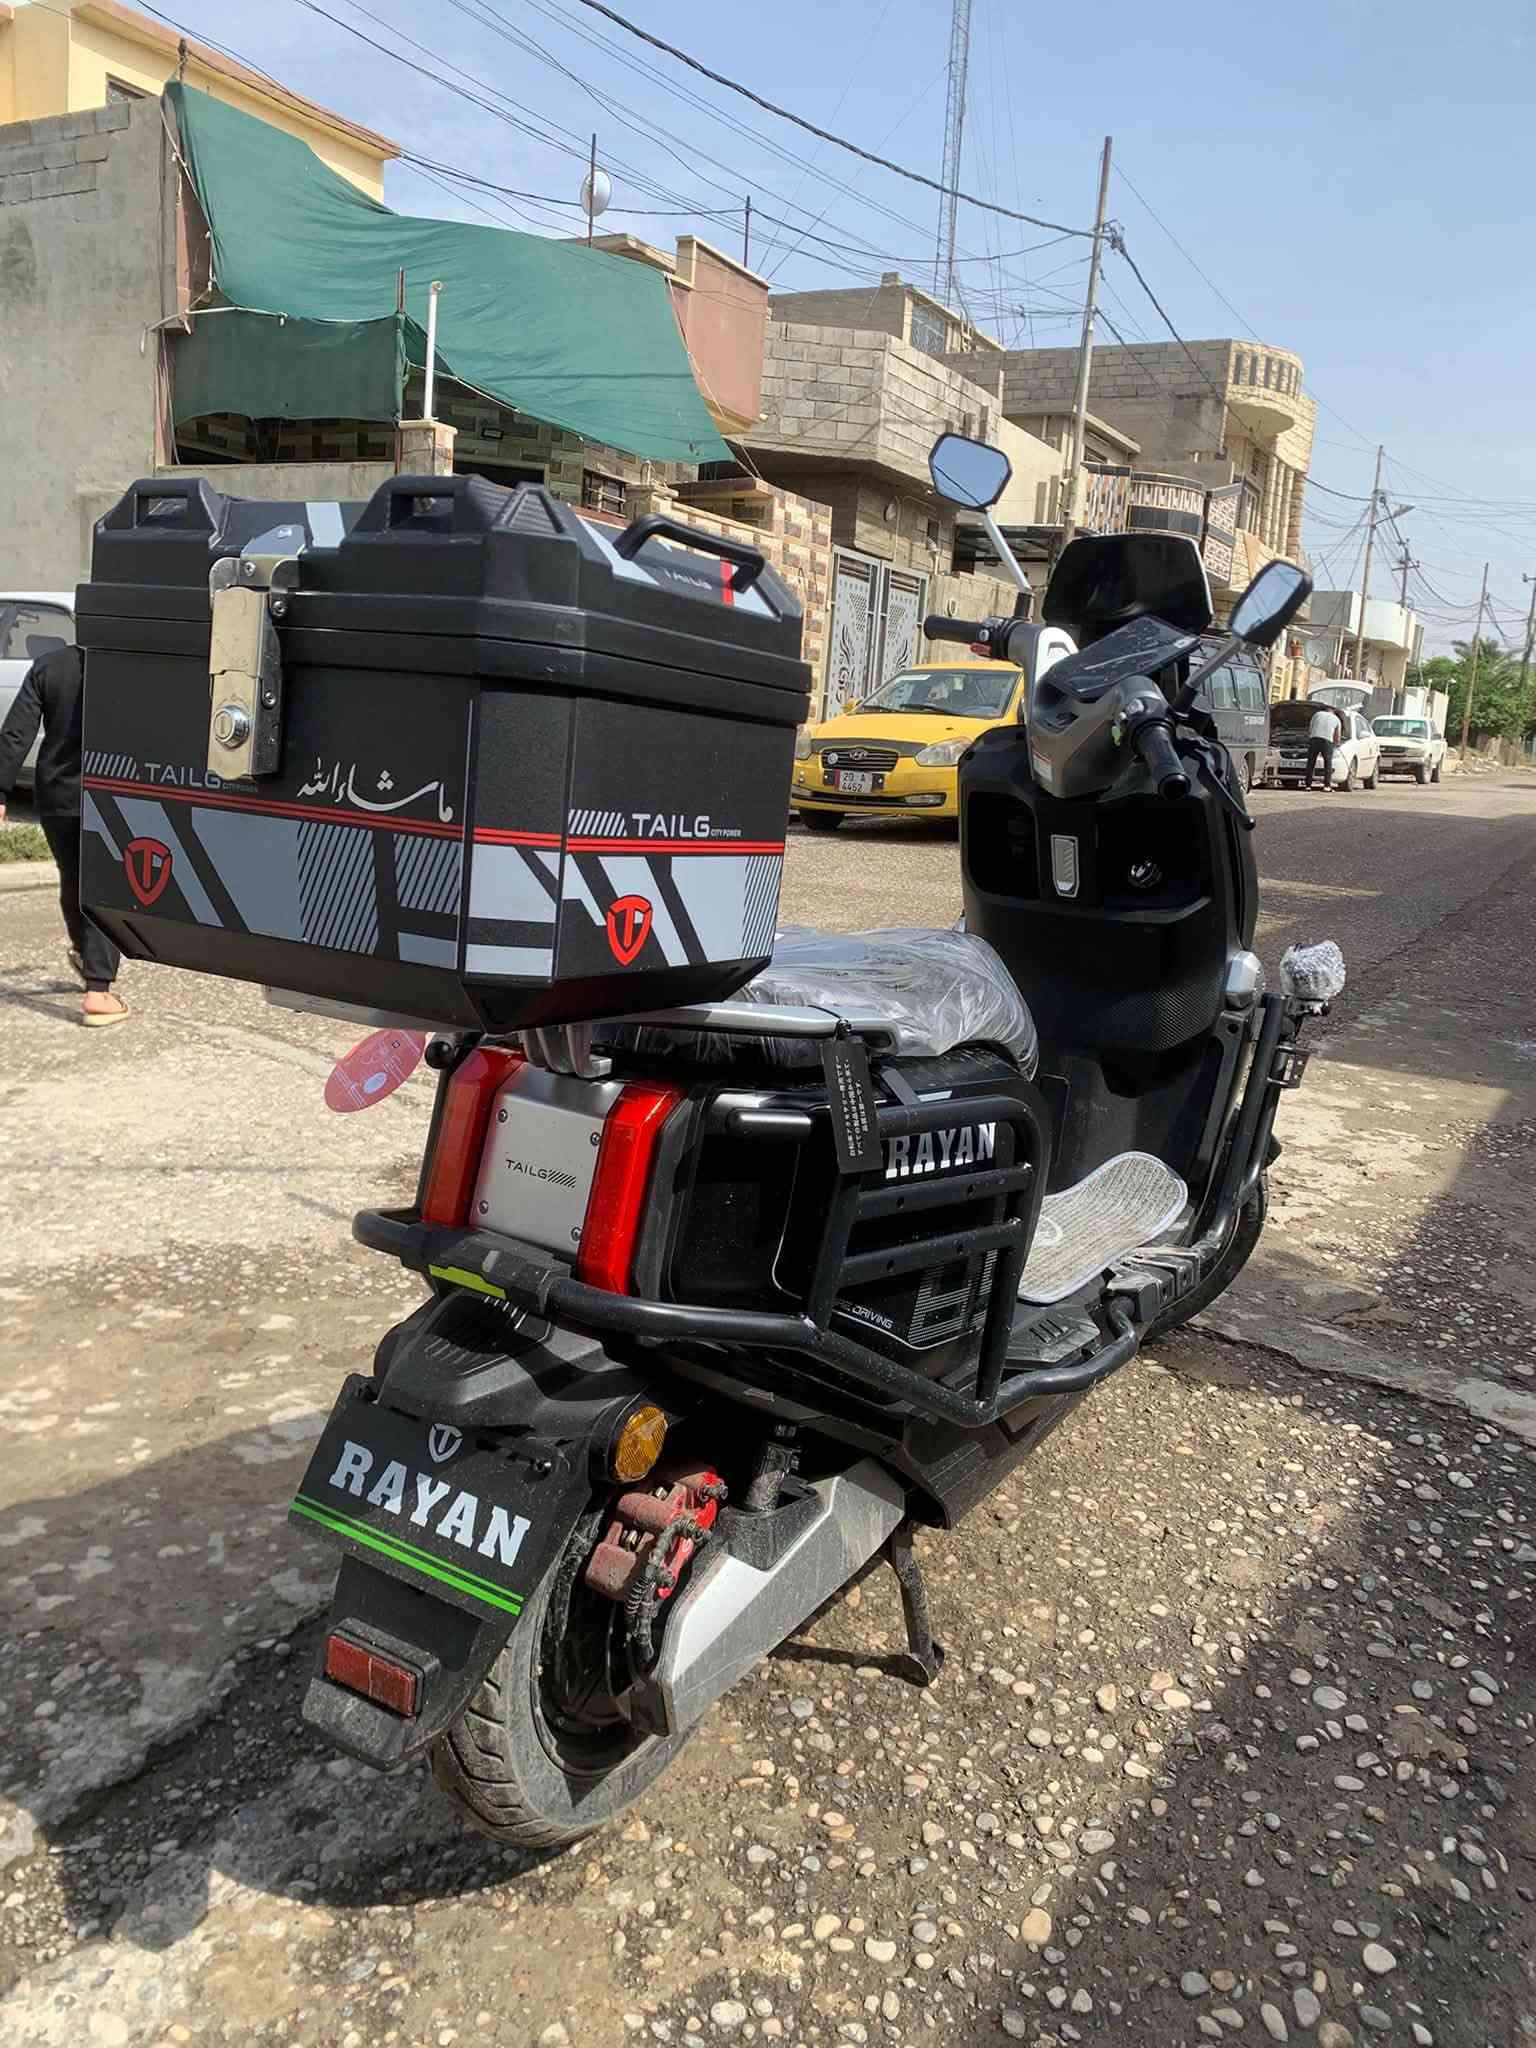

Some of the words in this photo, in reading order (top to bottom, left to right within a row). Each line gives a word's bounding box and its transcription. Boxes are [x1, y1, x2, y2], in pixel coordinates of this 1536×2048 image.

[144, 762, 222, 790] TAILG
[631, 813, 711, 839] TAILG
[884, 1121, 998, 1180] RAYAN
[505, 1159, 549, 1181] TAILG
[852, 1305, 895, 1329] DRIVING
[328, 1439, 532, 1568] RAYAN
